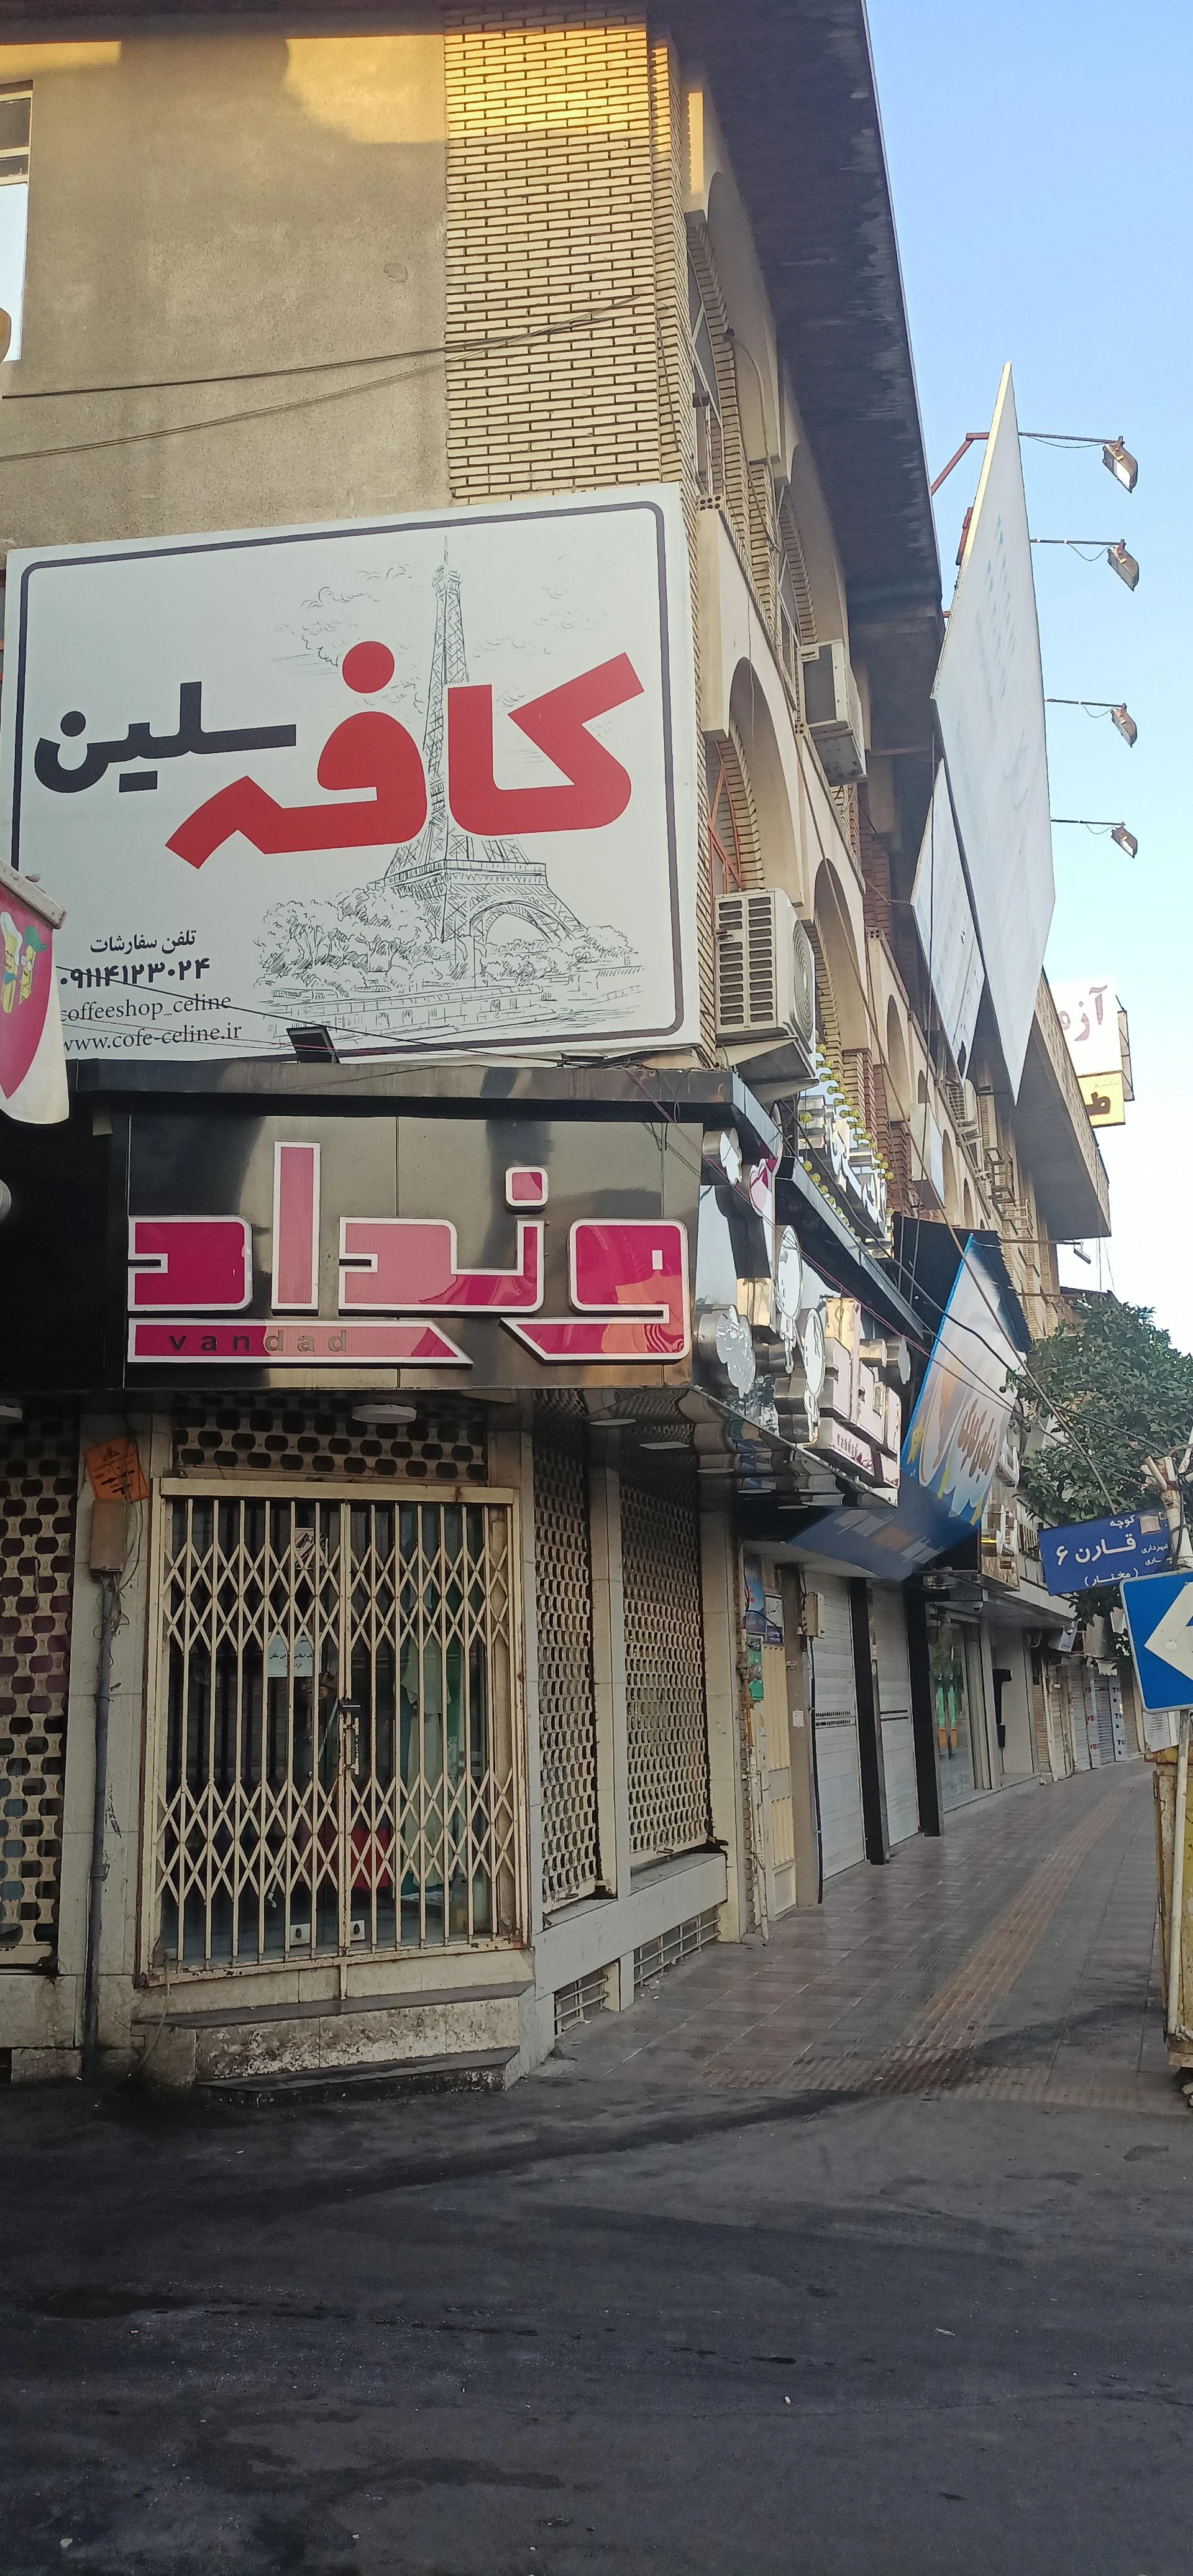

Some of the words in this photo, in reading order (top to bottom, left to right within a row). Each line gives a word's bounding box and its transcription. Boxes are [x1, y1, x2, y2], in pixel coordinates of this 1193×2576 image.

[34, 681, 296, 794] سلین
[166, 641, 644, 869] کافه
[90, 934, 157, 955] سفارشات
[162, 929, 196, 954] تلفن
[60, 957, 210, 989] ۰۹۱۱۴۱۲۳۰۲۴
[128, 1140, 690, 1364] ونداد
[168, 1329, 347, 1354] vandad
[1110, 1515, 1136, 1529] کوچه
[1056, 1545, 1068, 1566] ۶
[1075, 1533, 1136, 1564] قارن
[1141, 1542, 1169, 1554] شهرداری
[1145, 1557, 1162, 1566] ساری
